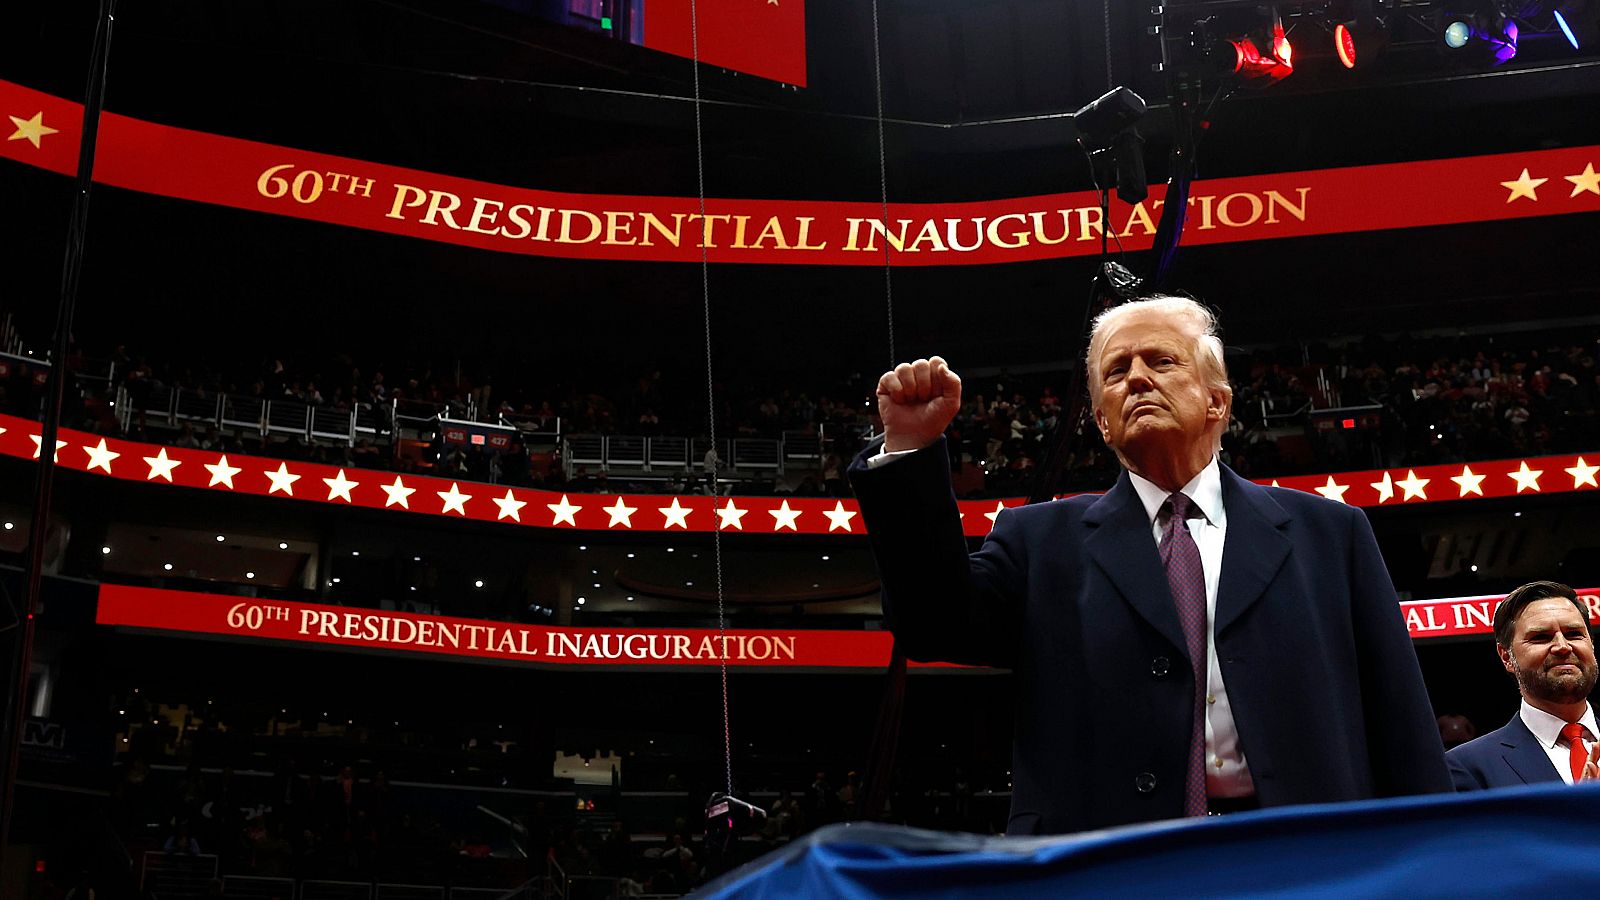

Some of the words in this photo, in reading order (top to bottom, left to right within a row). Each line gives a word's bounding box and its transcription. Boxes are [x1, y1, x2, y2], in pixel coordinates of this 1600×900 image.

[256, 163, 376, 204] 60TH
[385, 184, 827, 250] PRESIDENTIAL
[227, 603, 290, 630] 60TH
[298, 609, 538, 656] PRESIDENTIAL
[545, 632, 797, 660] INAUGURATION
